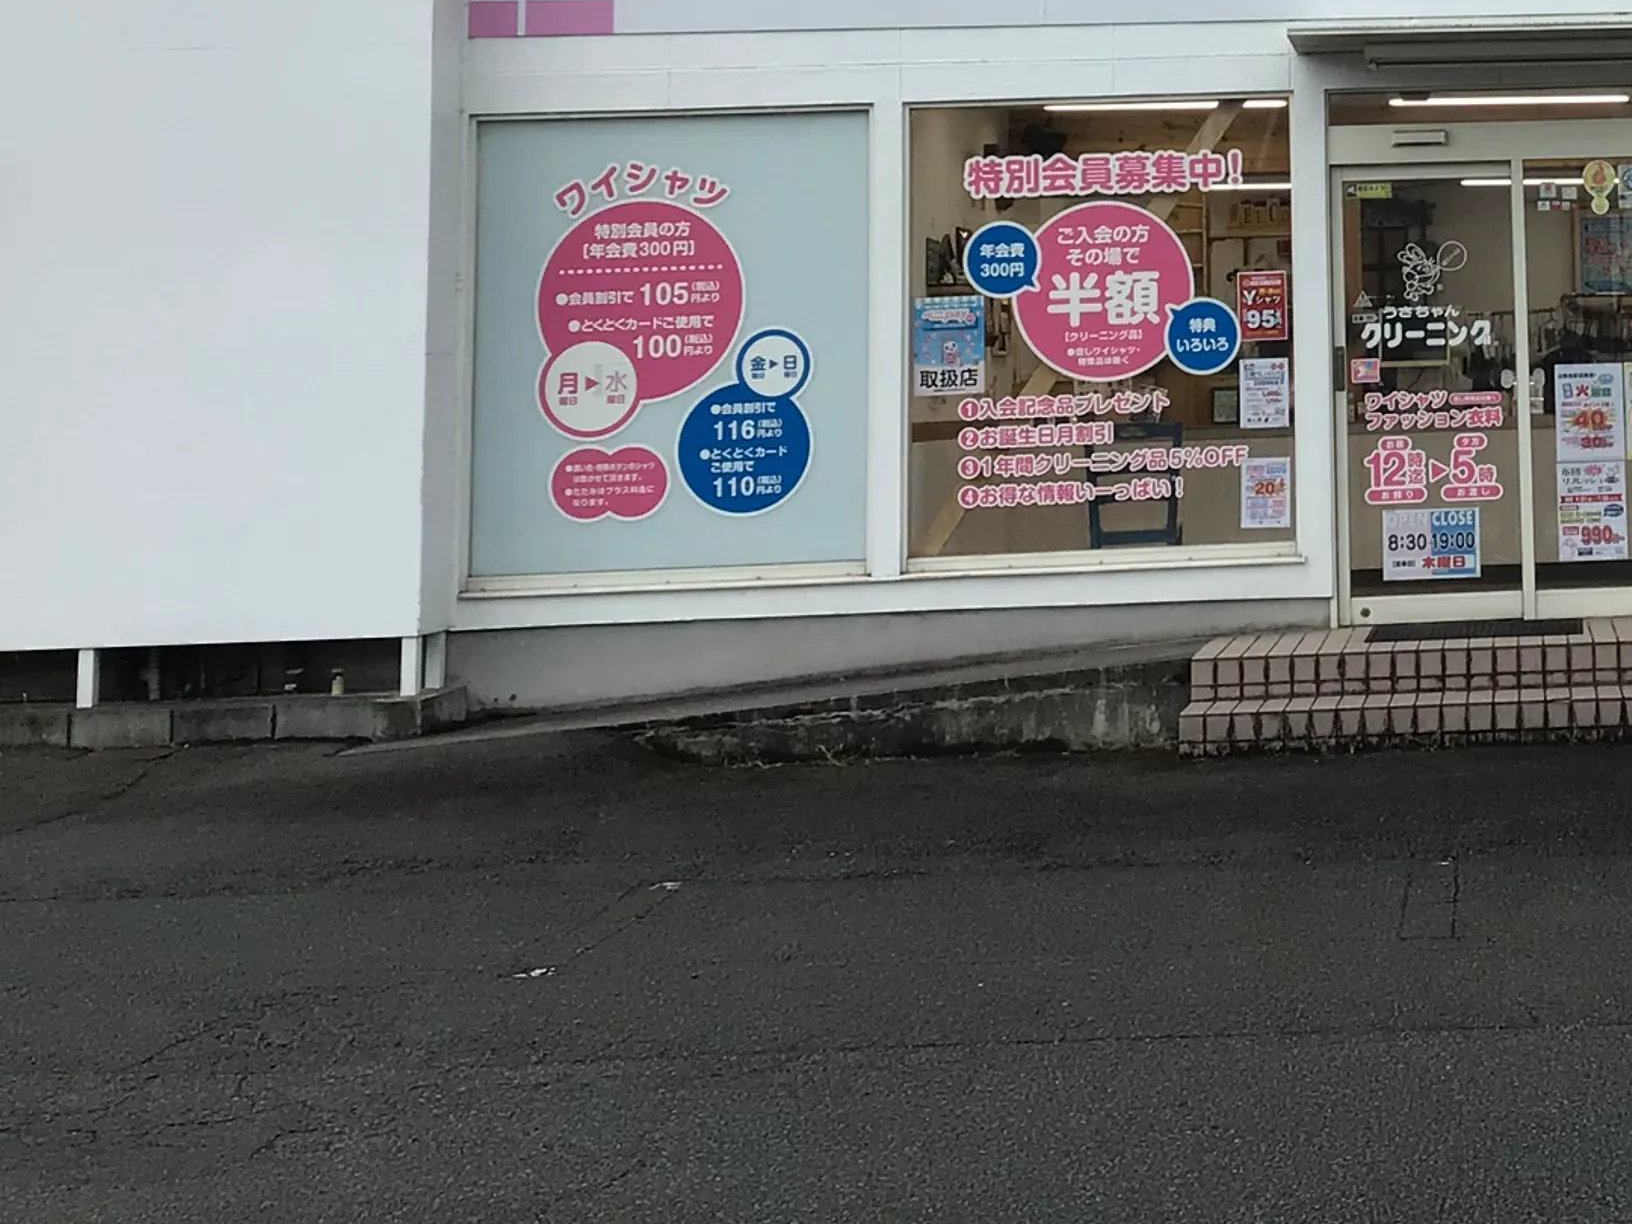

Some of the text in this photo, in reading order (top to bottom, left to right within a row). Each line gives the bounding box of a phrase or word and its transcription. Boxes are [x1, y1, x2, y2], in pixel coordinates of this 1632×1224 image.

[554, 161, 730, 216] ワイシャツ
[594, 222, 690, 240] 特別会員の方
[1056, 225, 1150, 245] ご入会の方
[979, 244, 1025, 258] 年会費
[1066, 247, 1140, 267] その場で
[980, 262, 1024, 278] 300円
[640, 282, 688, 306] 105
[1047, 271, 1160, 327] 半額
[1246, 309, 1279, 328] 95
[1383, 305, 1460, 319] うさちゃん
[1189, 317, 1216, 333] 特典
[1361, 319, 1492, 348] クリーニング
[633, 334, 682, 359] 100
[1176, 336, 1229, 352] いろいろ
[751, 355, 797, 371] 金 日
[557, 371, 628, 395] 月 水
[920, 368, 978, 388] 取扱店
[1364, 390, 1447, 410] ワイシャツ
[1365, 406, 1502, 431] ファッション衣料
[714, 420, 755, 441] 116
[1364, 450, 1407, 489] 12
[1450, 448, 1476, 484] 5
[713, 476, 755, 498] 110
[1432, 511, 1473, 526] CLOSE
[1388, 532, 1475, 551] 8:30 19:00
